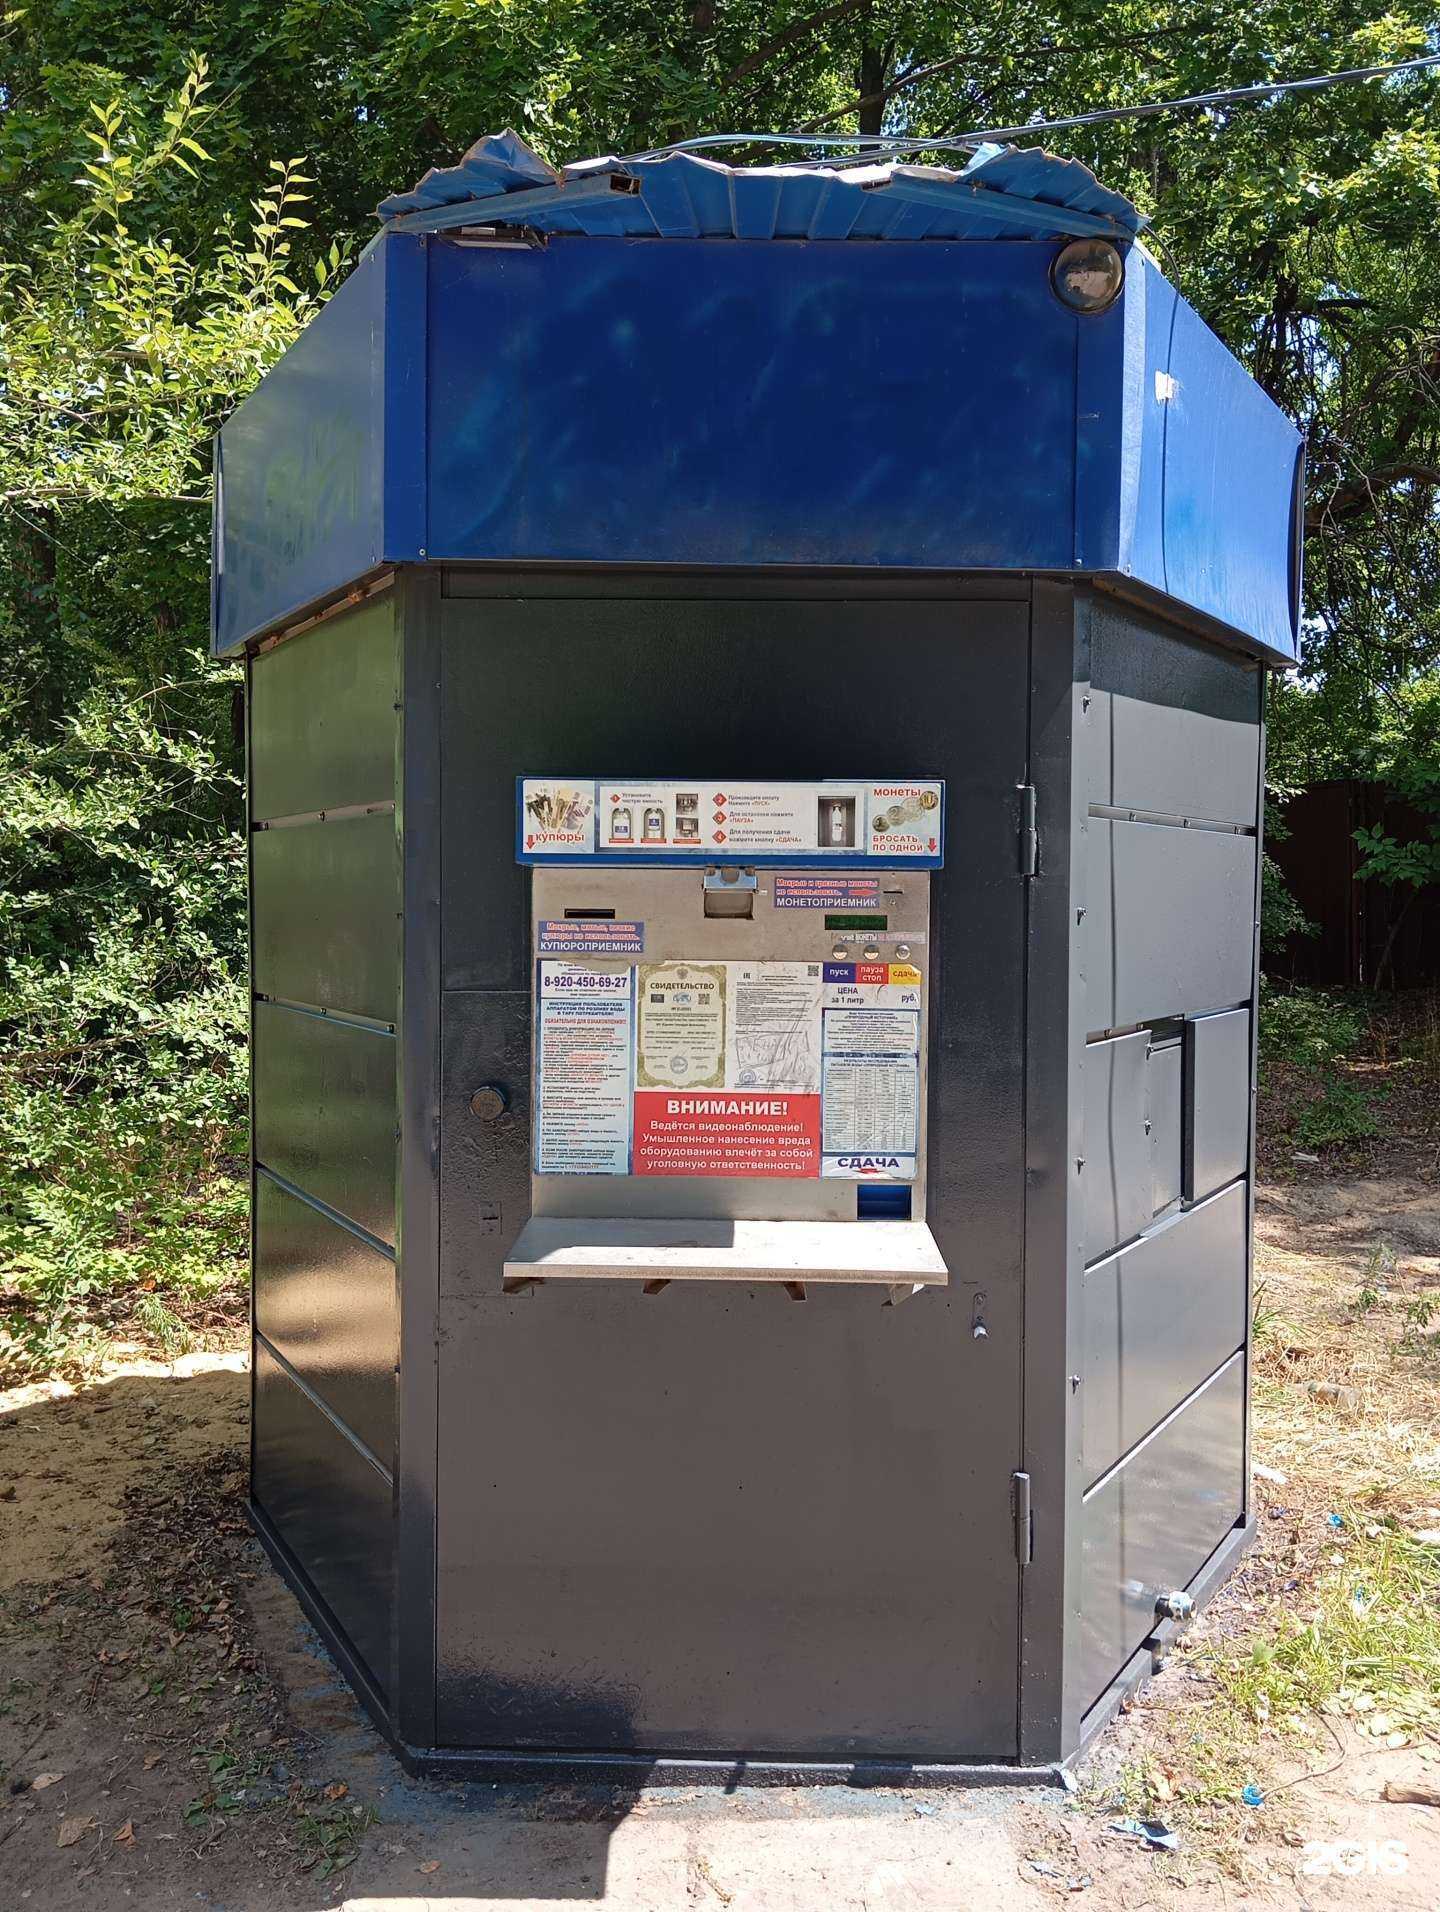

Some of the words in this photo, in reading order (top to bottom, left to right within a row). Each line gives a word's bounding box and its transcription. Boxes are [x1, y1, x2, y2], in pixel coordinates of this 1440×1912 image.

[874, 788, 920, 796] монеты
[536, 833, 584, 843] купюры
[889, 843, 923, 852] ОДНОЙ
[776, 879, 807, 888] Мокрые
[776, 898, 876, 906] МОНЕТОПРИЕМНИК
[540, 942, 640, 951] КУПЮРОПРИЕМНИК
[544, 976, 627, 988] 8-920-450-69-27
[901, 994, 917, 1003] руб.
[667, 1100, 788, 1115] ВНИМАНИЕ!
[650, 1120, 695, 1130] Ведётся
[699, 1122, 803, 1133] видеонаблюдение!
[642, 1133, 715, 1143] Умышленное
[778, 1138, 811, 1146] вреда
[640, 1147, 722, 1157] оборудованию
[725, 1148, 763, 1157] влечёт
[780, 1148, 813, 1158] собой
[647, 1160, 707, 1170] уголовную
[710, 1161, 805, 1170] ответственность!
[837, 1158, 900, 1169] СДАЧА
